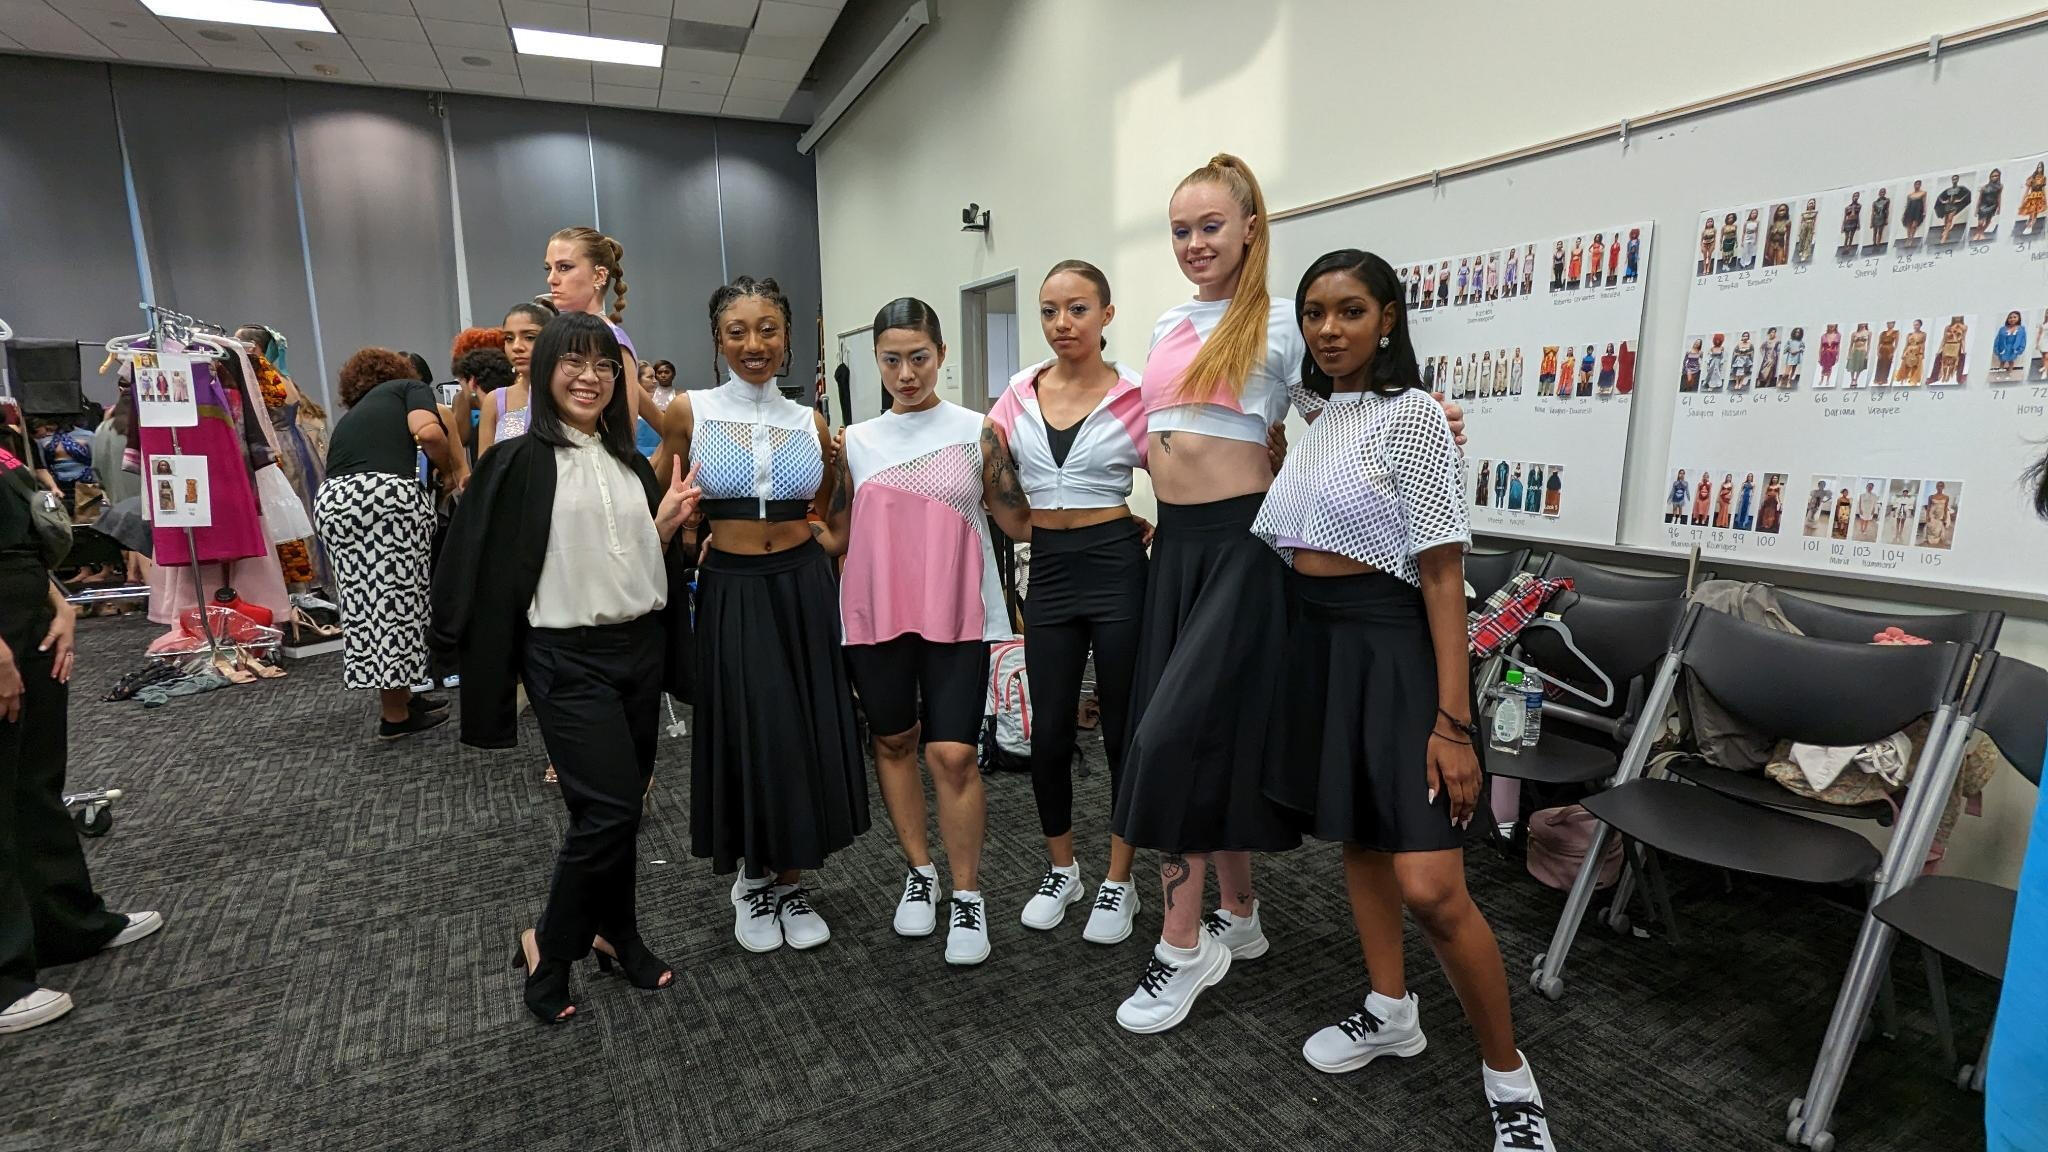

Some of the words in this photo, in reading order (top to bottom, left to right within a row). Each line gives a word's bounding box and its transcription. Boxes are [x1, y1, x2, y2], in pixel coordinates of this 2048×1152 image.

[2015, 242, 2031, 253] 31
[1838, 260, 1853, 268] 26
[1865, 258, 1880, 267] 27
[1897, 255, 1913, 264] 28
[1934, 249, 1953, 260] 29
[1969, 245, 1990, 256] 30
[1697, 278, 1707, 286] 21
[1717, 275, 1729, 283] 22
[1739, 272, 1751, 280] 23
[1764, 269, 1778, 277] 24
[1793, 266, 1807, 275] 25
[1681, 396, 1692, 407] 61
[1703, 395, 1716, 405] 62
[1729, 393, 1743, 404] 63
[1752, 393, 1767, 404] 64
[1777, 392, 1791, 403] 65
[1814, 392, 1828, 404] 66
[1842, 391, 1859, 403] 67
[1870, 391, 1884, 402] 68
[1893, 391, 1909, 402] 69
[1930, 391, 1945, 400] 70
[1992, 389, 2006, 400] 71
[2031, 387, 2048, 398] 72
[2017, 404, 2044, 417] Hong
[1668, 526, 1680, 539] 96
[1690, 529, 1703, 540] 97
[1711, 531, 1724, 541] 98
[1732, 532, 1745, 544] 99
[1757, 536, 1776, 547] 100
[1803, 540, 1820, 552] 101
[1831, 543, 1844, 556] 102
[1852, 545, 1872, 557] 103
[1881, 548, 1905, 563] 104
[1920, 552, 1942, 567] 105
